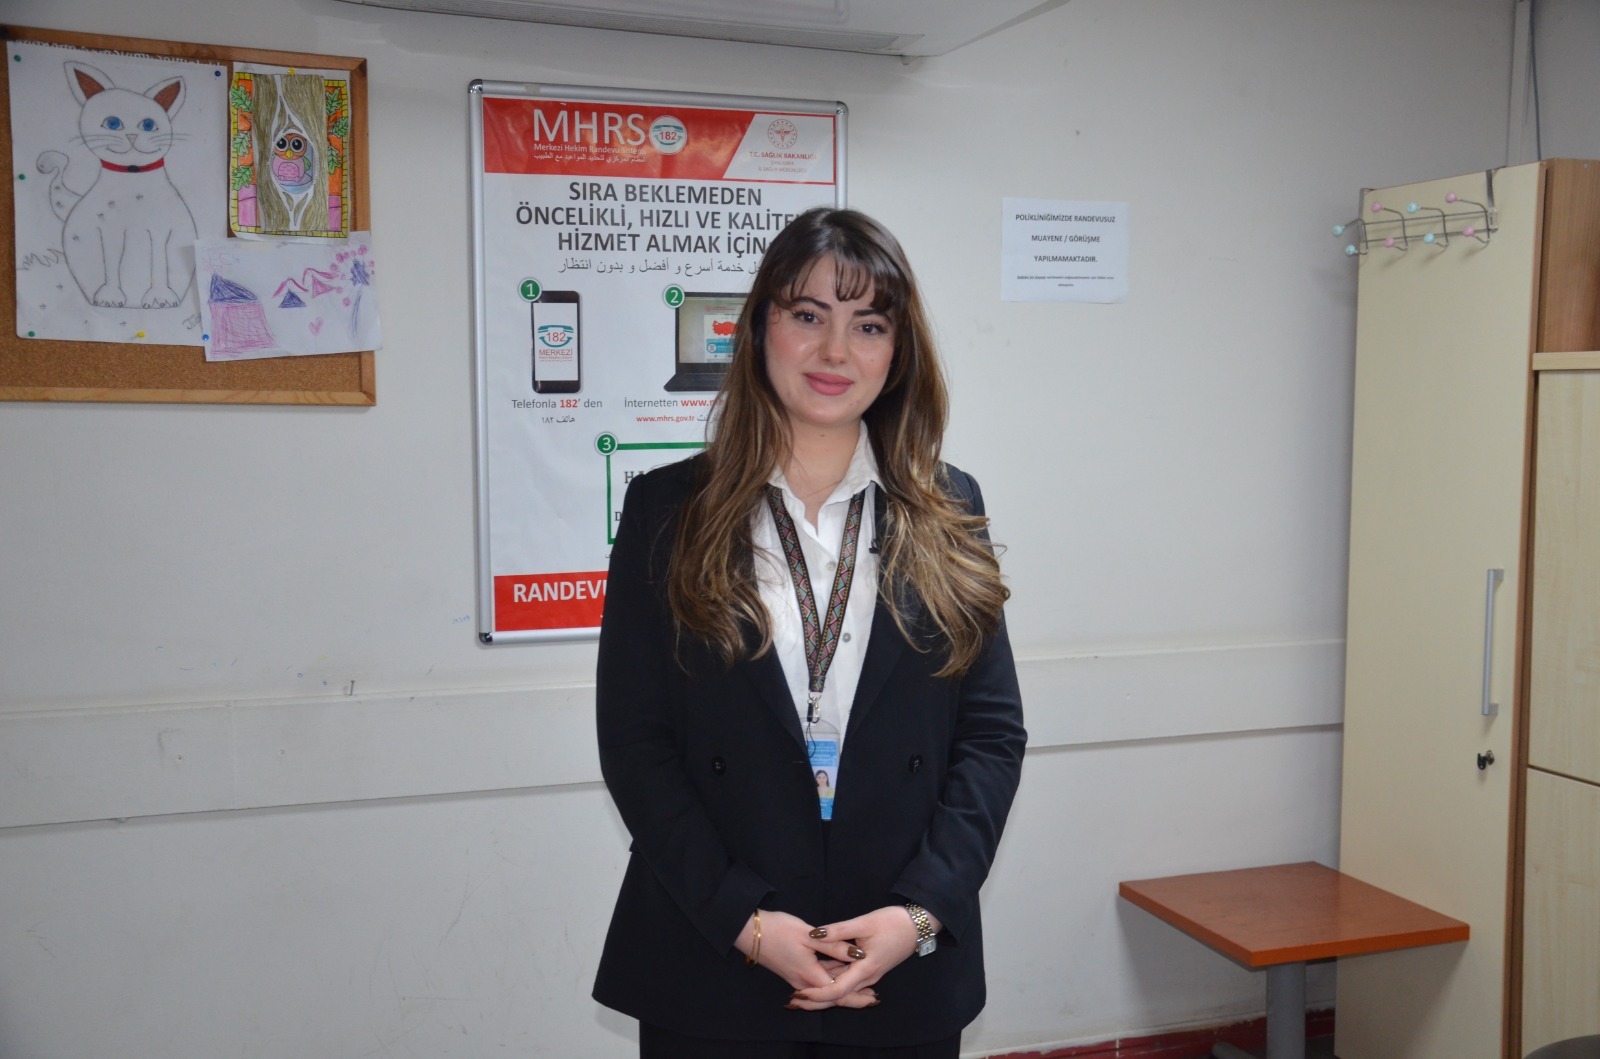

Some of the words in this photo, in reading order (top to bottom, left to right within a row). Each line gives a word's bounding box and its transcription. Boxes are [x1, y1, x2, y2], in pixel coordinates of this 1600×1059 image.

[533, 108, 646, 146] MHRS
[659, 131, 677, 140] 182
[533, 143, 563, 151] Merkezi
[564, 144, 588, 152] Hekim
[761, 151, 783, 159] SAĞLIK
[569, 181, 618, 202] SIRA
[624, 183, 762, 206] BEKLEMEDEN
[515, 201, 633, 231] ÖNCELİKLİ,
[640, 209, 689, 228] HIZLI
[695, 210, 721, 229] VE
[728, 208, 800, 231] KALİTE
[1074, 214, 1116, 223] RANDEVUSUZ
[558, 227, 640, 252] HİZMET
[645, 234, 721, 253] ALMAK
[1031, 234, 1063, 242] MUAYENE
[1068, 234, 1101, 243] GÖRÜŞME
[596, 260, 624, 274] بدون
[717, 260, 745, 272] خدمة
[526, 283, 536, 297] 1
[670, 289, 680, 304] 2
[546, 331, 566, 342] 182
[511, 398, 557, 409] Telefonla
[583, 398, 603, 408] den
[624, 396, 678, 408] İnternetten
[635, 414, 695, 423] www.mhrs.gov.tr
[602, 437, 611, 451] 3
[513, 579, 607, 603] RANDEV
